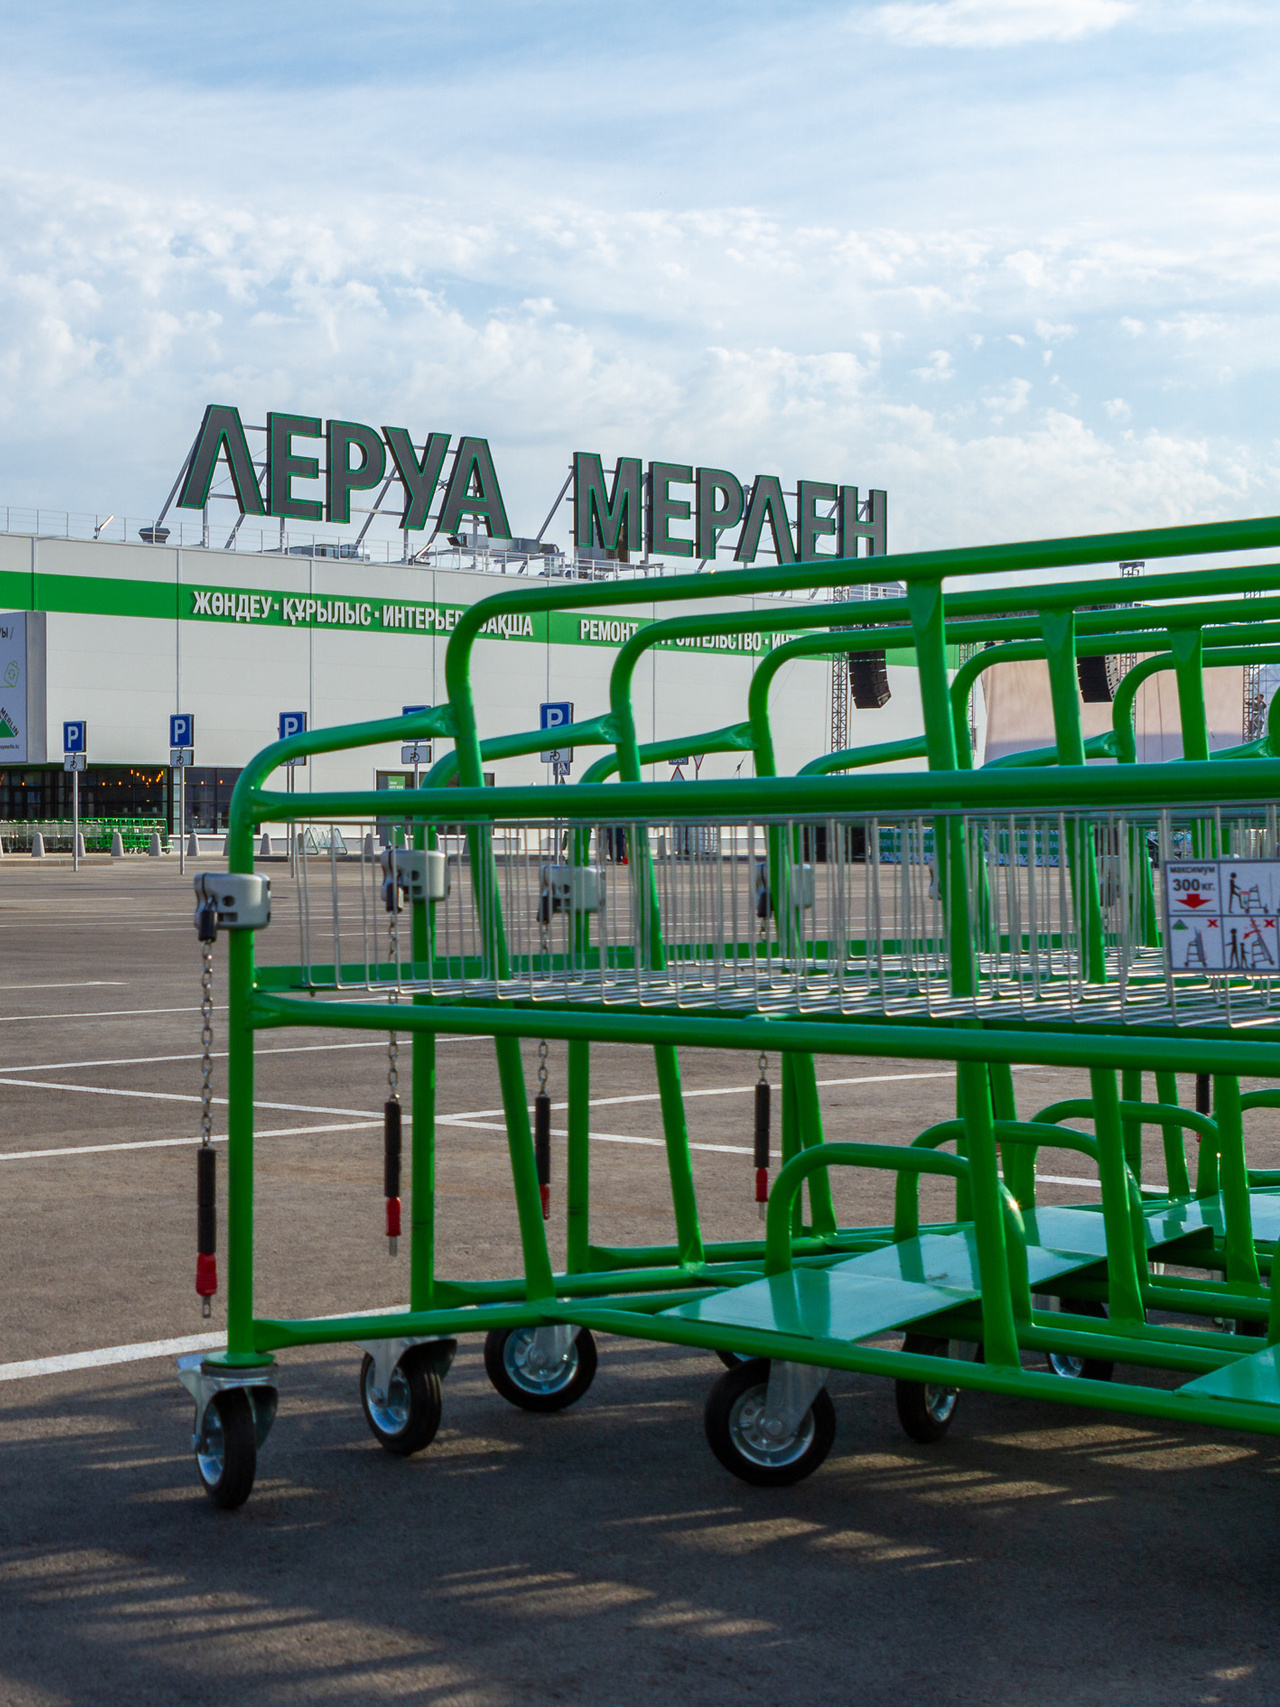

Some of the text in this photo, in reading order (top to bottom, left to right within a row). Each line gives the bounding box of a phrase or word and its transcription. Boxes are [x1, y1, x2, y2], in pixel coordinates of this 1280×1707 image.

[177, 403, 888, 565] ЛЕРУА МЕРЛЕН
[192, 590, 272, 622] ЖӨНДЕУ
[282, 597, 371, 626] ҚҰРЫЛЫС
[580, 619, 638, 642] РЕМОНТ
[0, 707, 20, 737] MERLIN
[174, 719, 186, 743] P
[67, 726, 79, 748] P
[1173, 879, 1200, 892] 300
